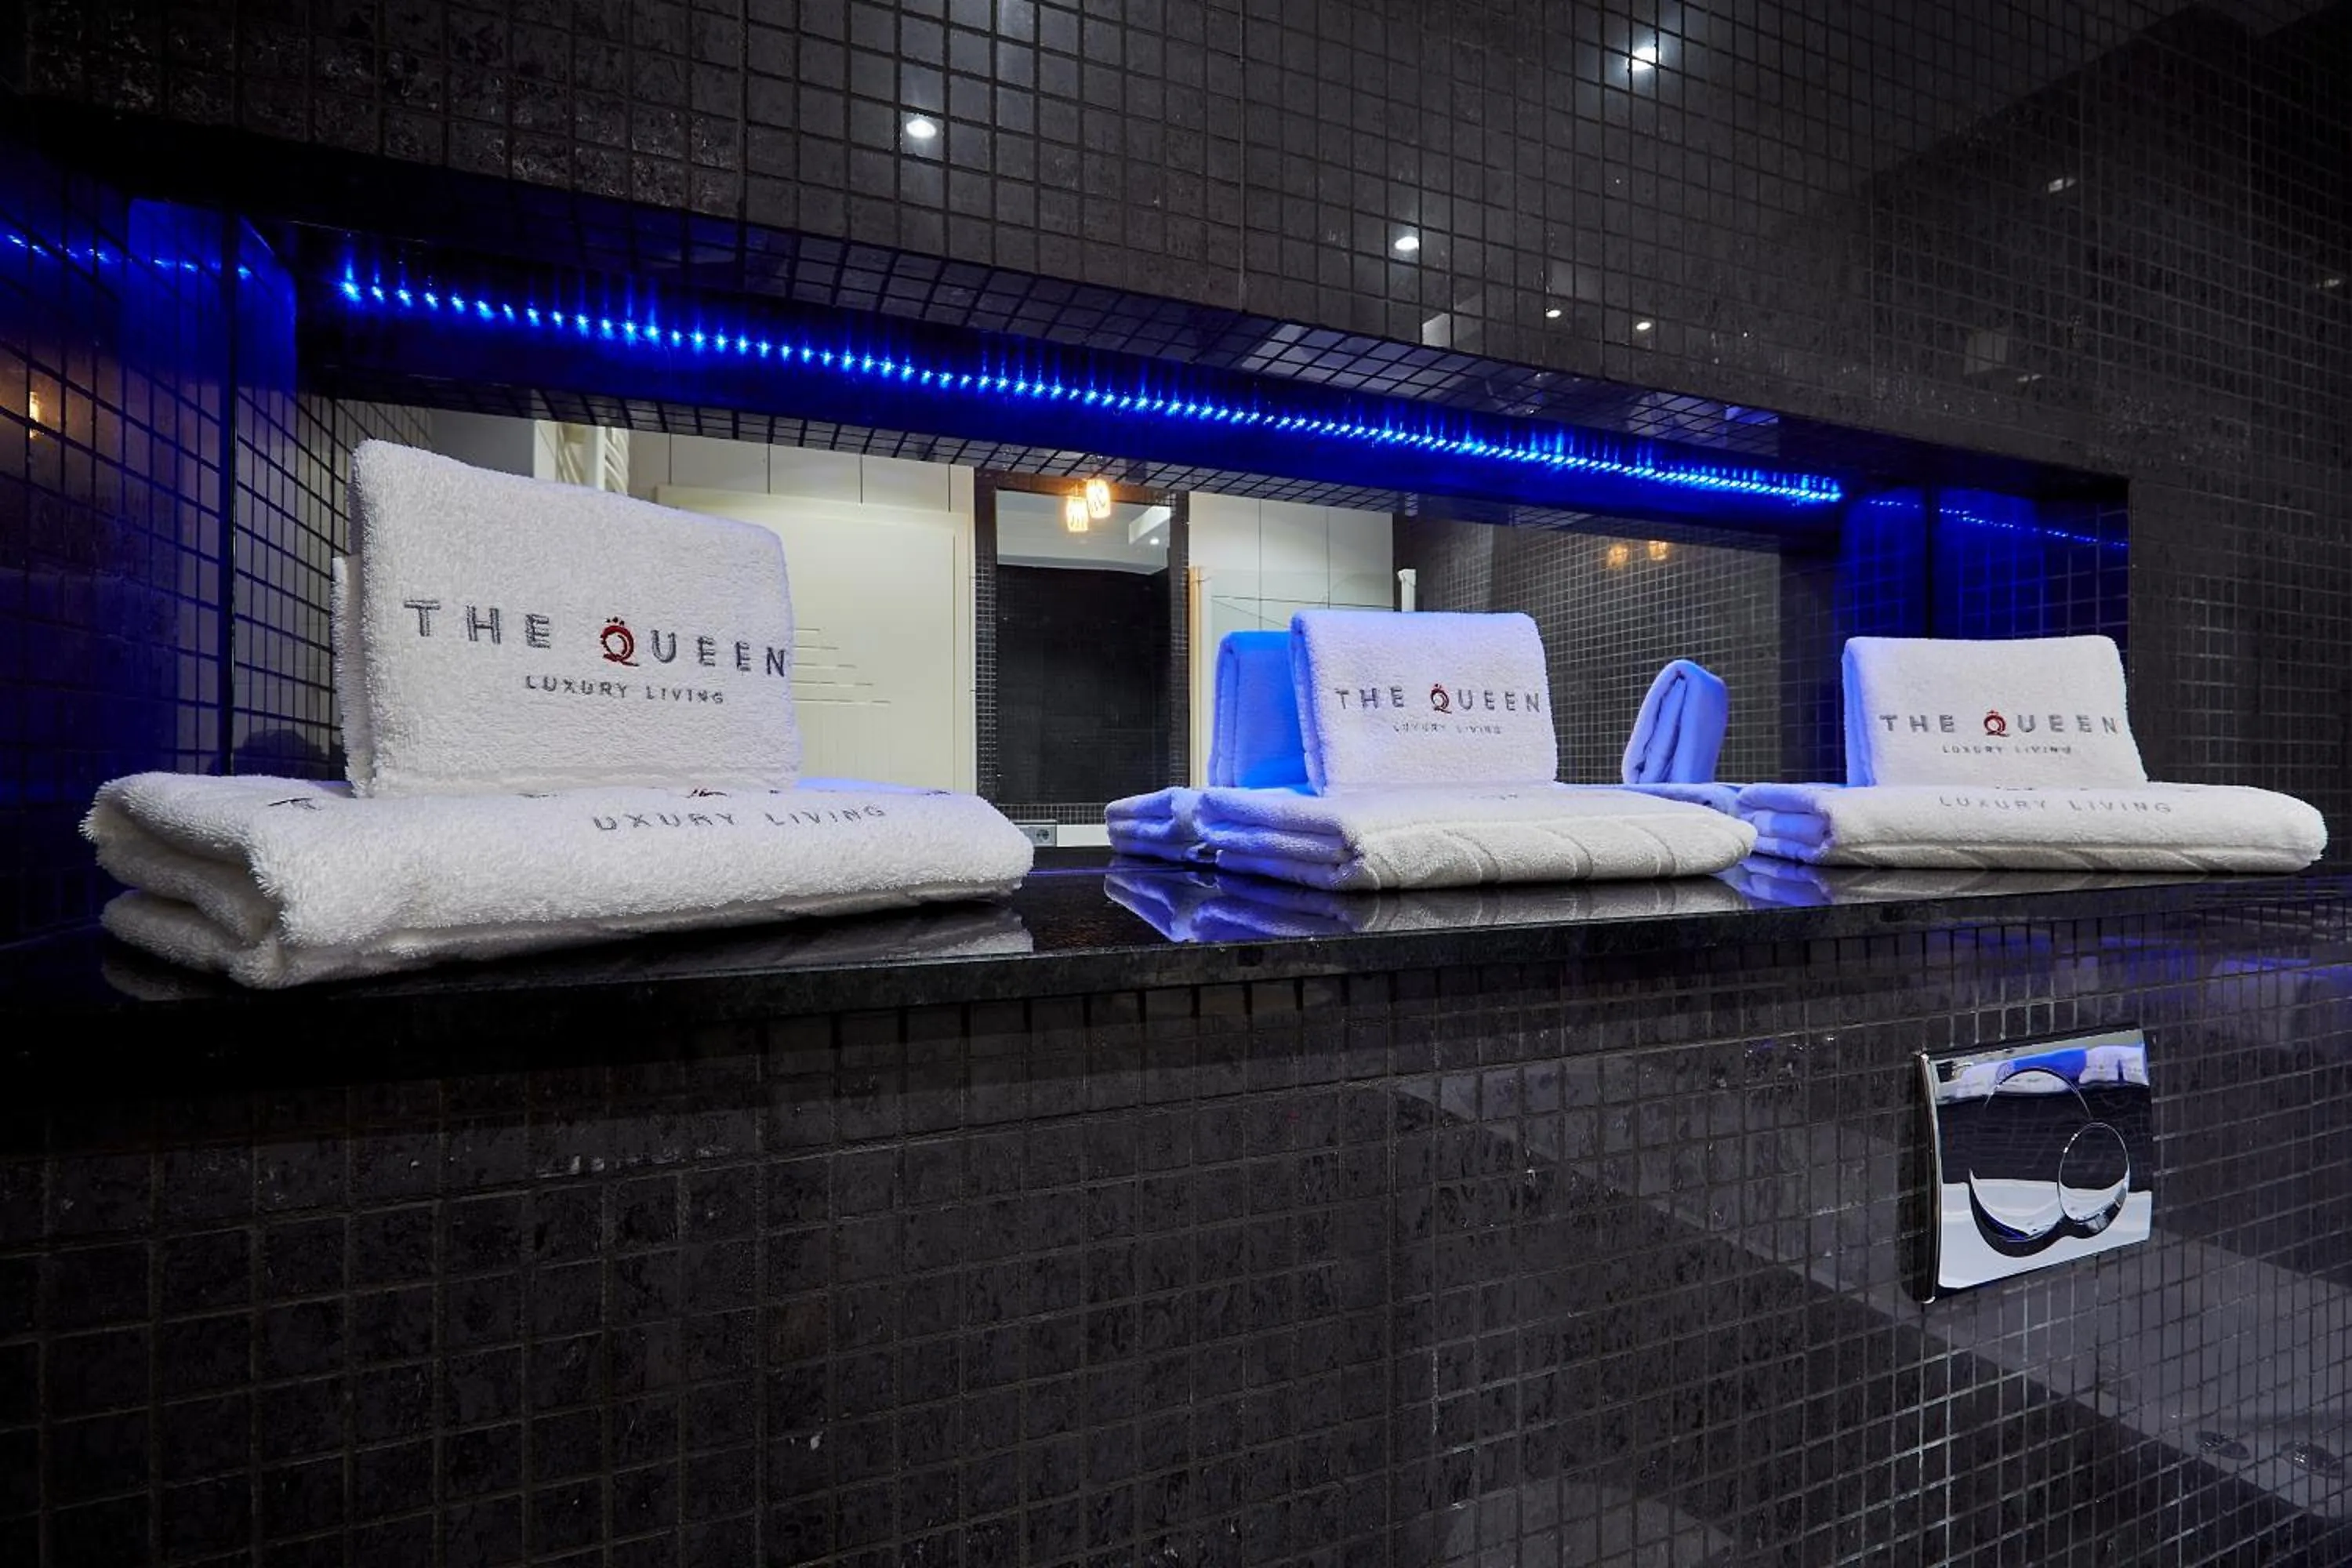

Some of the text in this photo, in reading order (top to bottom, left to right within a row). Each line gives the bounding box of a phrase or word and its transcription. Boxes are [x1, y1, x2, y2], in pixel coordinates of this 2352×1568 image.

[403, 599, 786, 677] THE QUEEN
[525, 674, 724, 704] LUXURY LIVING
[1334, 683, 1541, 714] THE QUEEN
[1879, 710, 2118, 737] THE QUEEN
[1942, 745, 2072, 755] LUXURY LIVING
[764, 805, 886, 826] LIVING
[1939, 795, 2172, 813] LUXURY LIVING
